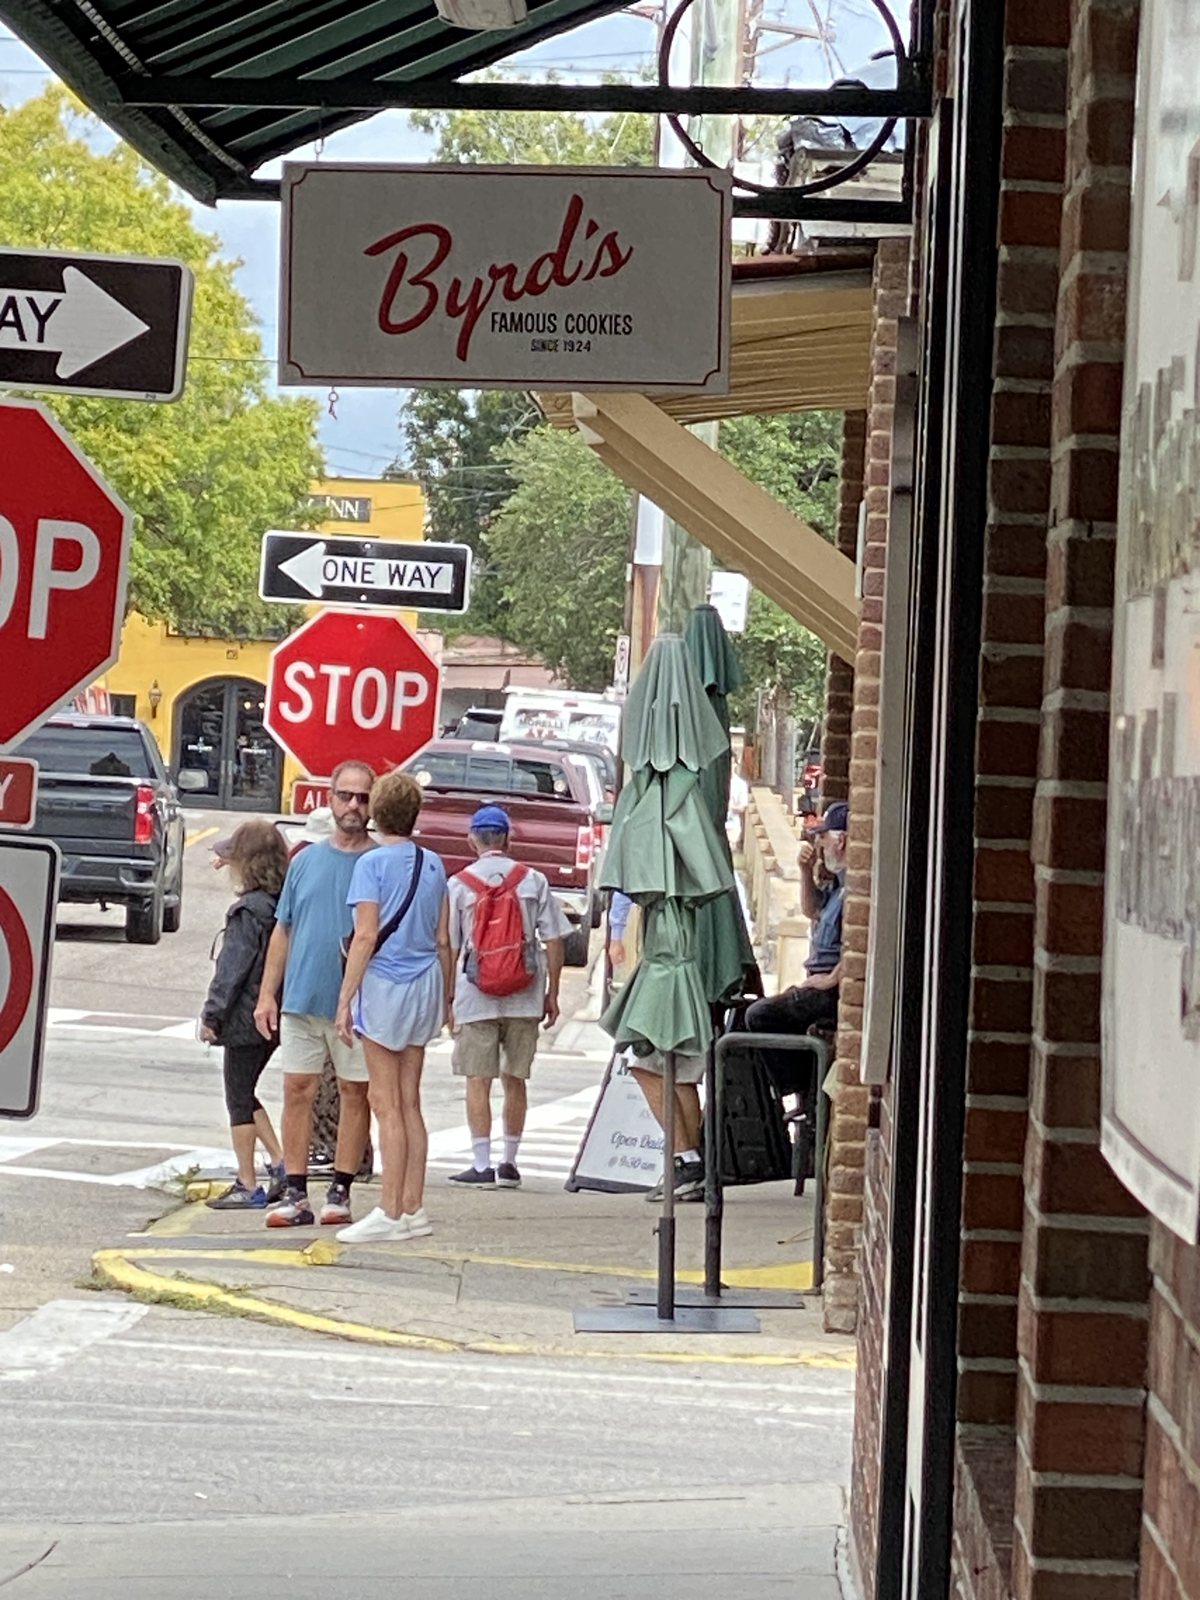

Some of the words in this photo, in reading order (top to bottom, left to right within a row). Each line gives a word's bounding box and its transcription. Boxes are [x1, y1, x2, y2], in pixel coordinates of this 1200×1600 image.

[362, 193, 634, 362] Byrd's
[491, 311, 557, 334] FAMOUS
[564, 313, 633, 335] COOKIES
[530, 338, 559, 352] SINCE
[563, 339, 592, 352] 1924
[322, 558, 375, 584] ONE
[388, 563, 443, 589] WAY
[278, 660, 429, 731] STOP
[610, 1130, 638, 1149] Open
